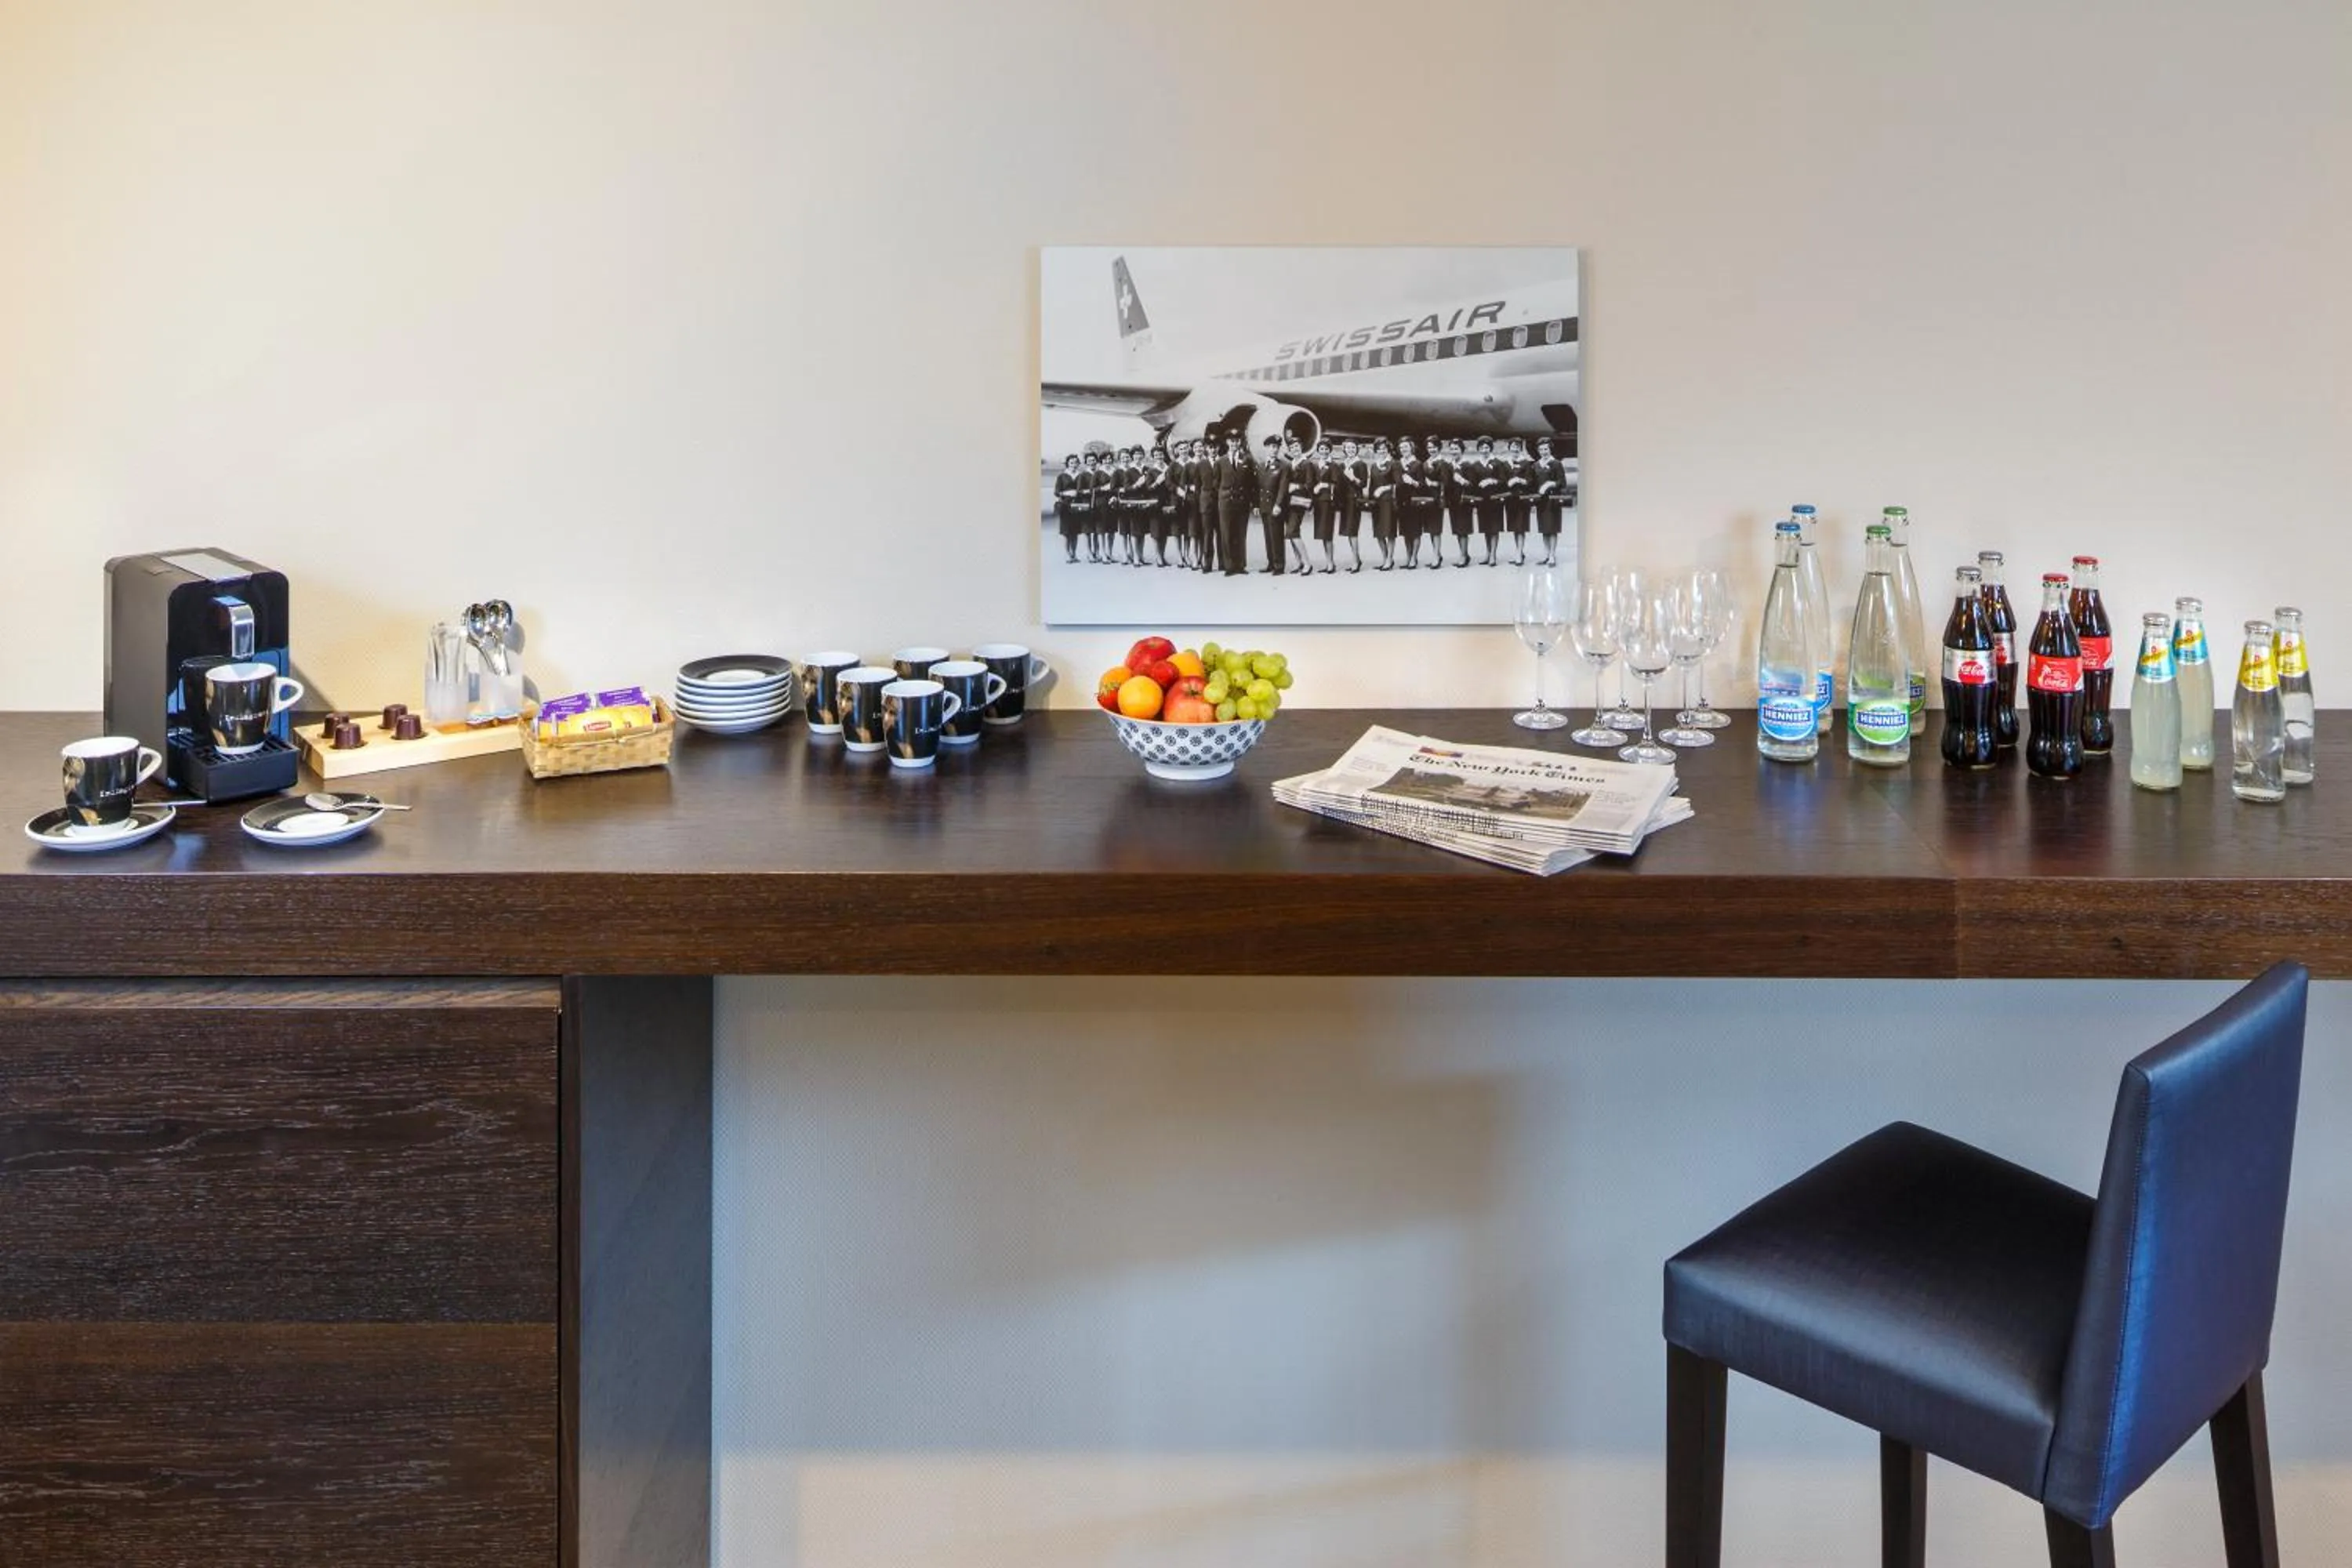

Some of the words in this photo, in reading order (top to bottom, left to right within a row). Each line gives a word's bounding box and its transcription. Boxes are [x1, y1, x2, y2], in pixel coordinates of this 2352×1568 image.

[1275, 300, 1506, 361] SWISSAIR
[1860, 713, 1904, 725] HENNIEZ
[1409, 754, 1445, 766] The
[1450, 760, 1489, 771] New
[1491, 765, 1541, 777] York
[1544, 770, 1606, 783] Times
